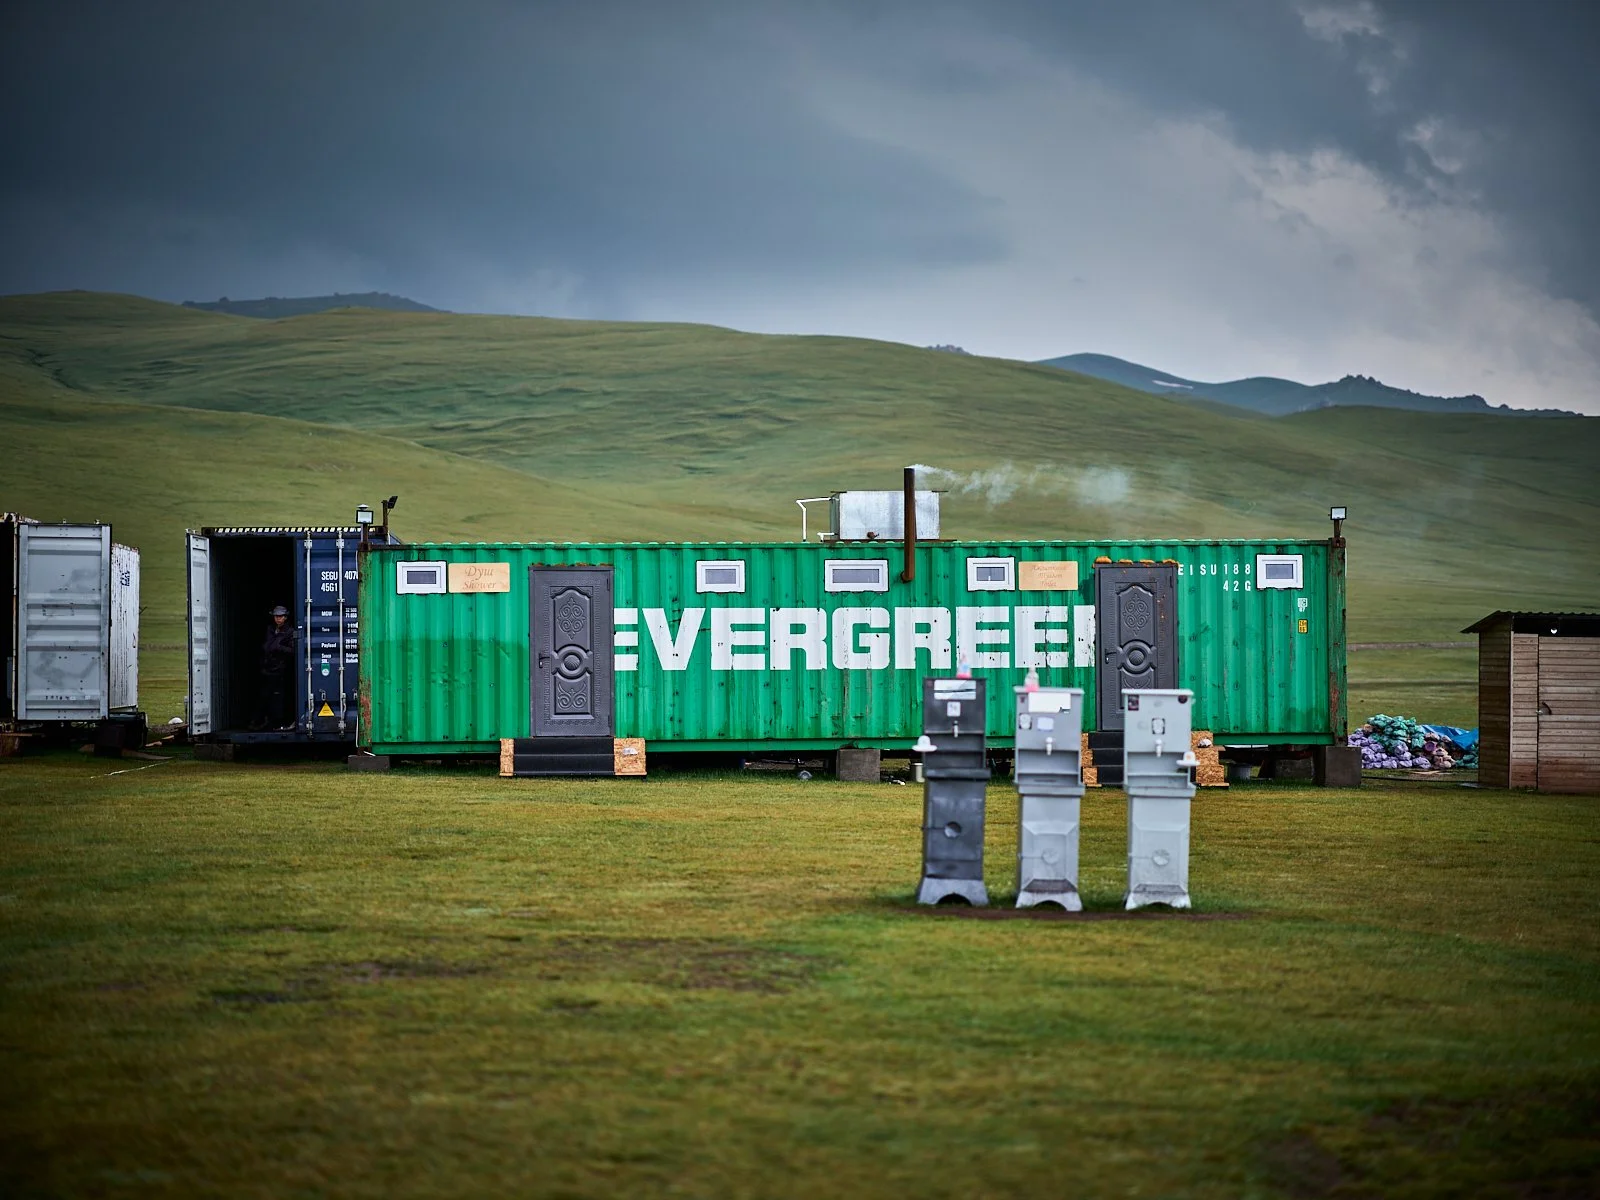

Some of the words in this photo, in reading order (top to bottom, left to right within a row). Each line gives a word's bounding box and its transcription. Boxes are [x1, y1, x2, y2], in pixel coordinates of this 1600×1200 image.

[1178, 563, 1217, 576] EISU
[1223, 563, 1251, 576] 188
[321, 570, 338, 581] SEGU
[320, 582, 338, 592] 45G1
[1223, 580, 1252, 592] 42G
